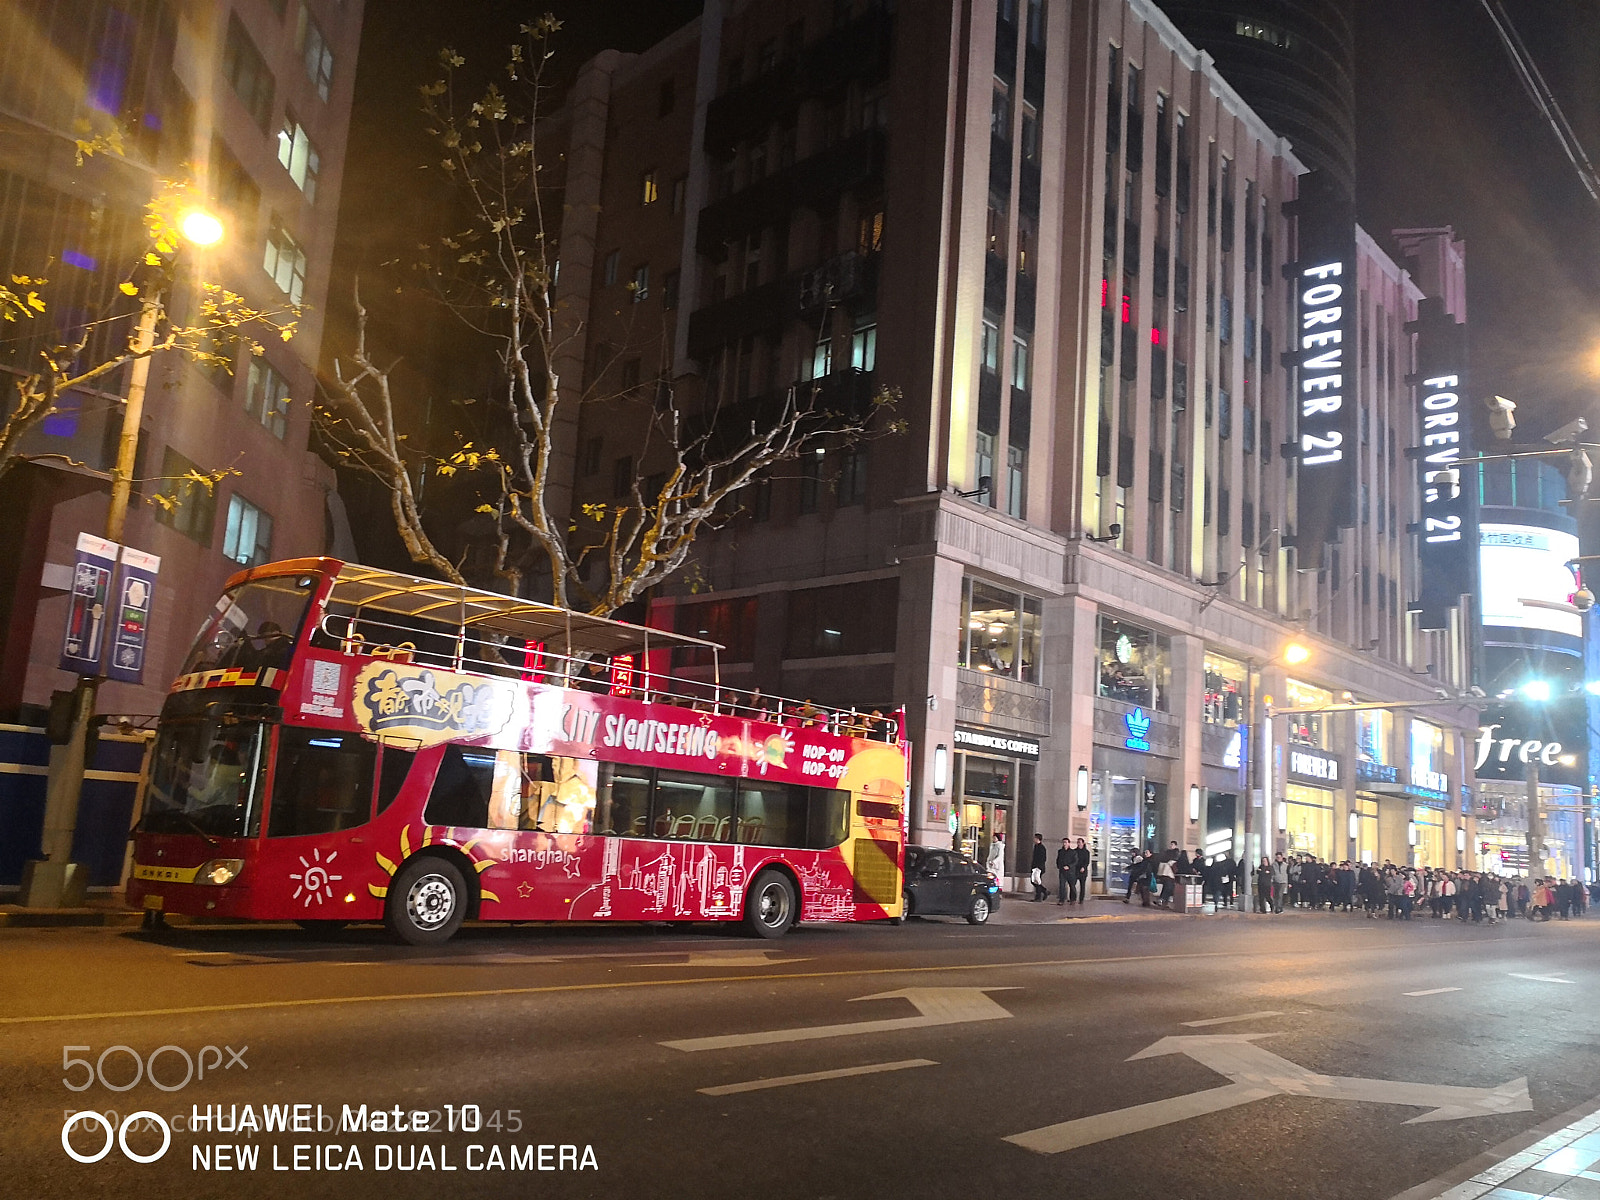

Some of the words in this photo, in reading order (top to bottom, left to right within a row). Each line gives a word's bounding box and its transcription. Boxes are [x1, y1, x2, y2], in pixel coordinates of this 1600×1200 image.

[1302, 262, 1343, 417] FOREVER
[1302, 431, 1343, 466] 21
[1425, 515, 1462, 543] 21
[603, 713, 719, 760] SIGHTSEEING
[954, 730, 1007, 750] STARBUCKS
[1007, 739, 1039, 755] COFFEE
[1473, 724, 1562, 770] free
[802, 744, 845, 762] HOP-ON
[801, 761, 849, 779] HOP-OFF
[501, 839, 567, 869] shanghai
